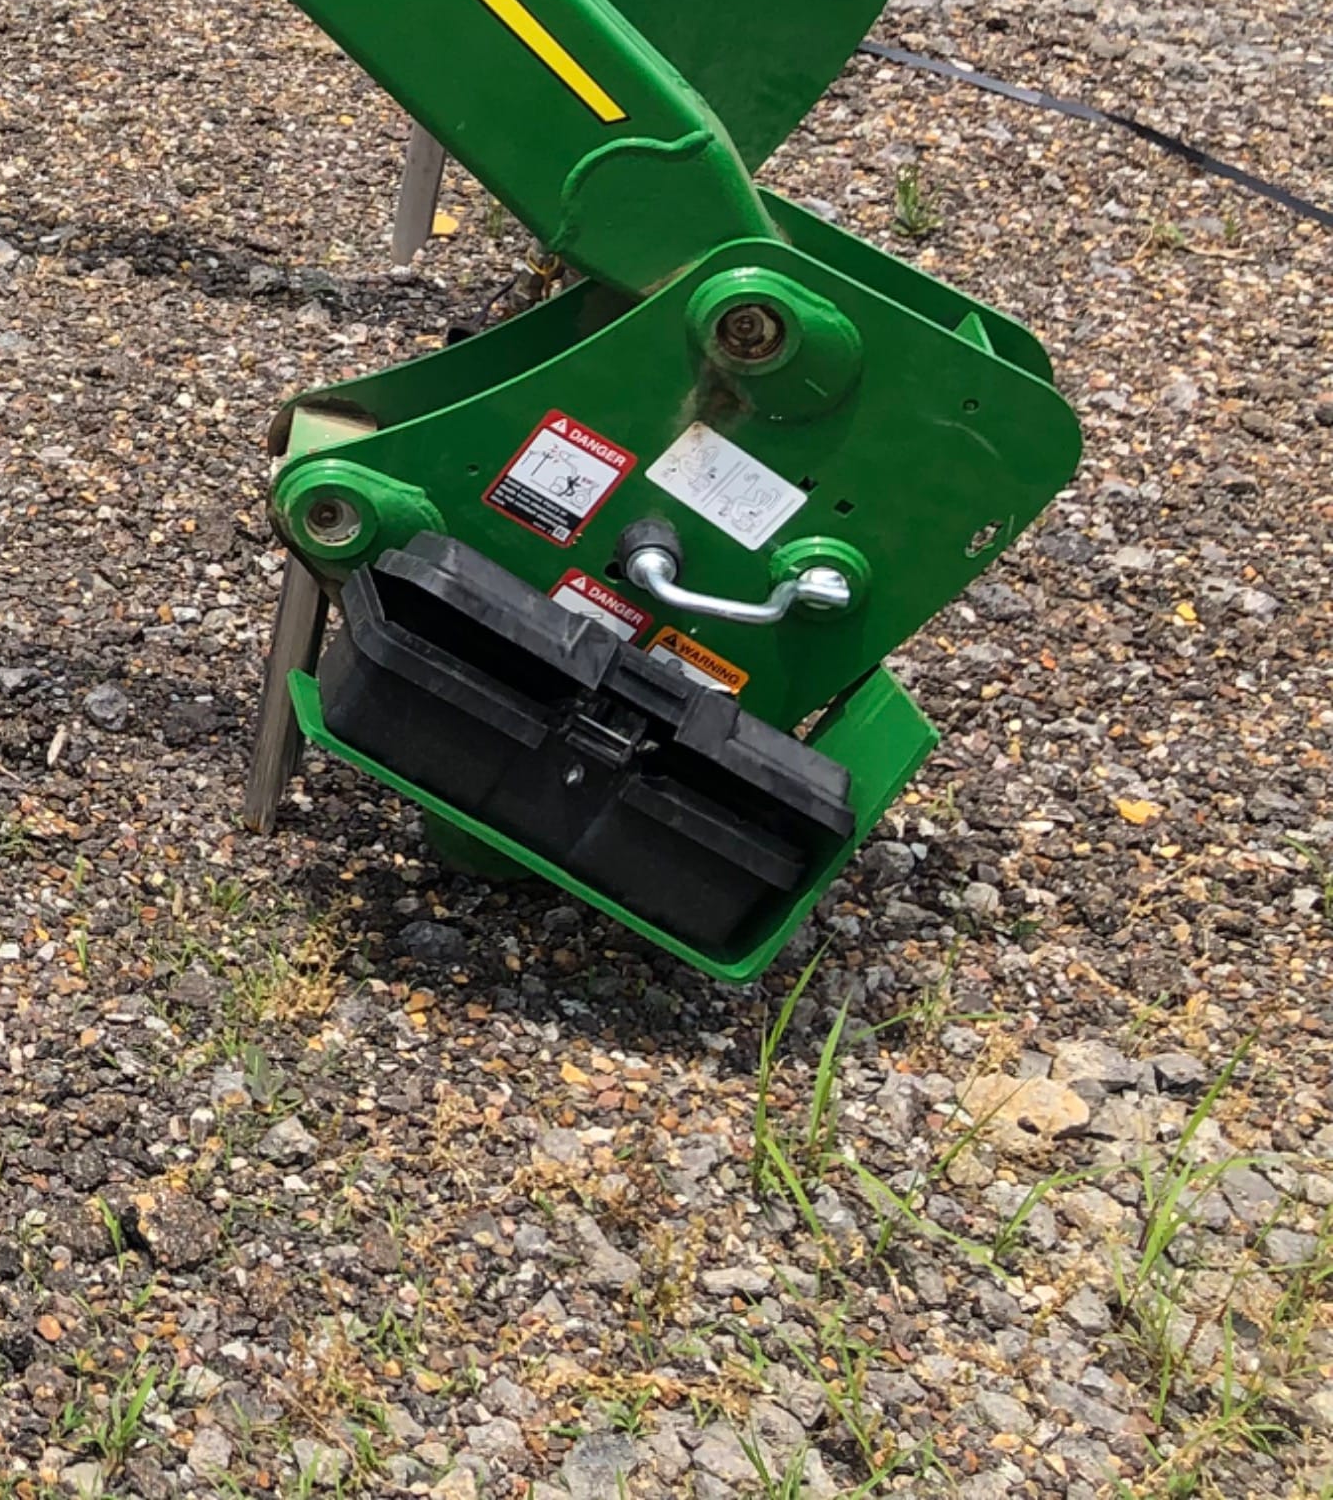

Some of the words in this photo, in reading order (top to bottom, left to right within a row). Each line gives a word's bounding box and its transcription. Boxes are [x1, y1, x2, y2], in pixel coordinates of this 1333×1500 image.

[569, 428, 627, 468] DANGER
[587, 586, 644, 627] DANGER
[680, 643, 741, 686] WARNING
